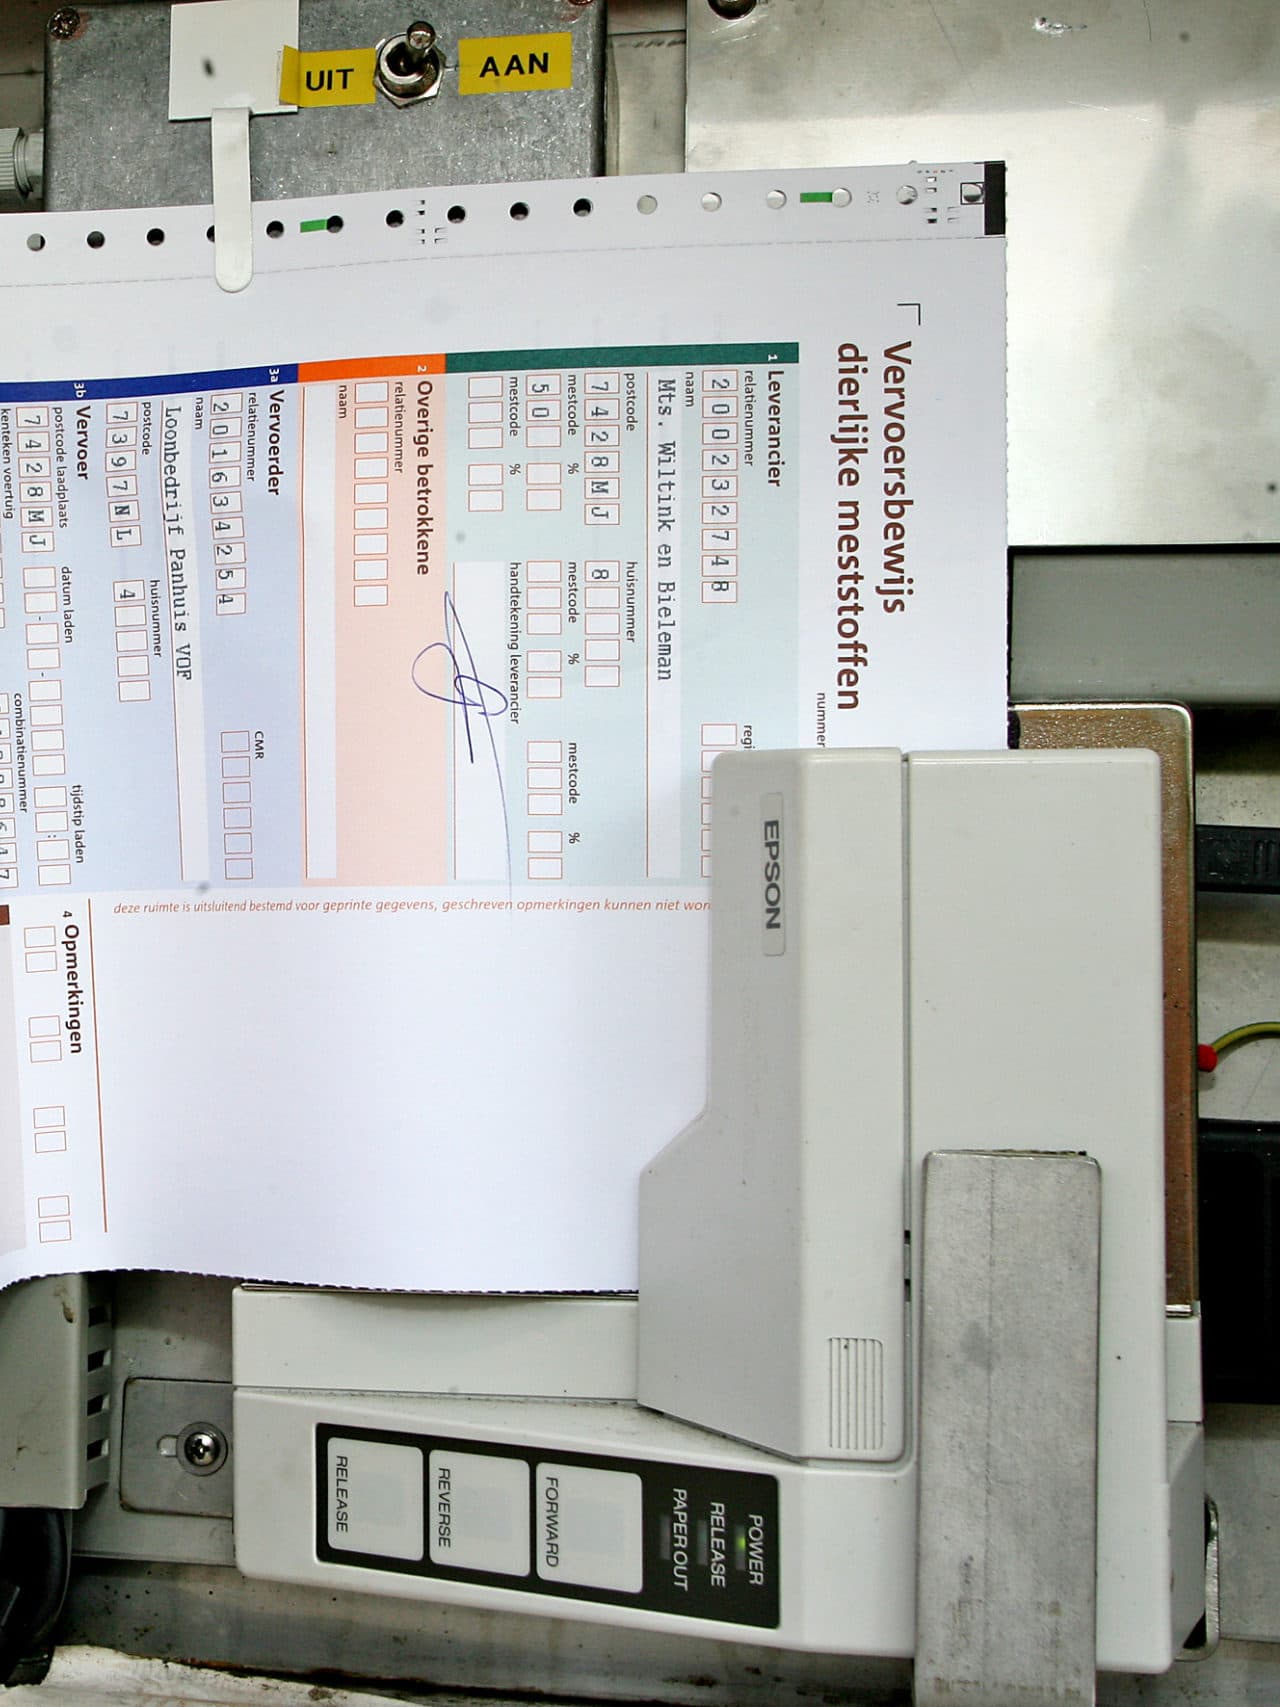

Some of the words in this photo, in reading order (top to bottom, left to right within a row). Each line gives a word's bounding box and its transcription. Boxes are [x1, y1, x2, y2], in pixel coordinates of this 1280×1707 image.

[306, 68, 355, 91] UIT
[479, 53, 549, 78] AAN
[195, 397, 205, 430] naam
[338, 385, 348, 419] naam
[413, 380, 433, 457] Overige
[509, 377, 521, 436] mestcode
[567, 374, 579, 436] mestcode
[624, 373, 637, 431] postcode
[657, 379, 675, 427] Mts.
[685, 371, 696, 407] naam
[744, 370, 755, 465] relatienummer
[831, 343, 868, 486] dierlijke
[0, 408, 12, 464] kenteken
[53, 407, 66, 462] postcode
[77, 406, 90, 480] Vervoer
[141, 402, 153, 455] postcode
[246, 392, 258, 481] relatienummer
[267, 390, 284, 496] Vervoerder
[393, 381, 406, 473] relatienummer
[767, 370, 785, 486] Leverancier
[3, 468, 14, 519] voertuig
[56, 466, 69, 528] laadplaats
[163, 407, 183, 536] Loonbedrijf
[657, 441, 676, 532] Wiltink
[876, 341, 914, 613] Vervoersbewijs
[417, 464, 434, 575] betrokkene
[62, 567, 72, 605] datum
[657, 544, 671, 568] en
[149, 579, 162, 657] huisnummer
[170, 549, 190, 632] Panhuis
[508, 562, 521, 650] handtekening
[568, 562, 579, 623] mestcode
[626, 561, 637, 642] huisnummer
[837, 501, 867, 710] meststoffen
[63, 610, 74, 643] laden
[657, 582, 676, 680] Bieleman
[175, 643, 191, 680] VOF
[510, 654, 521, 724] leverancier
[13, 693, 28, 813] combinatienummer
[254, 731, 264, 759] CMR
[816, 693, 827, 747] nummer
[71, 784, 83, 826] tijdstip
[569, 742, 579, 804] mestcode
[74, 830, 85, 864] laden
[764, 820, 781, 929] EPSON
[113, 902, 140, 913] deze
[143, 902, 180, 913] ruimte
[194, 900, 246, 912] uitsluitend
[250, 900, 292, 911] bestemd
[295, 902, 320, 911] voor
[323, 899, 372, 913] geprinte
[375, 899, 437, 913] gegevens,
[442, 898, 513, 912] geschreven
[517, 899, 600, 912] opmerkingen
[604, 899, 651, 911] kunnen
[656, 899, 680, 911] niet
[61, 925, 83, 1054] Opmerkingen
[335, 1455, 348, 1532] RELEASE
[438, 1468, 451, 1547] REVERSE
[545, 1476, 559, 1567] FORWARD
[672, 1488, 688, 1547] PAPER
[672, 1550, 688, 1590] OUT
[710, 1502, 725, 1587] RELEASE
[748, 1514, 763, 1585] POWER
